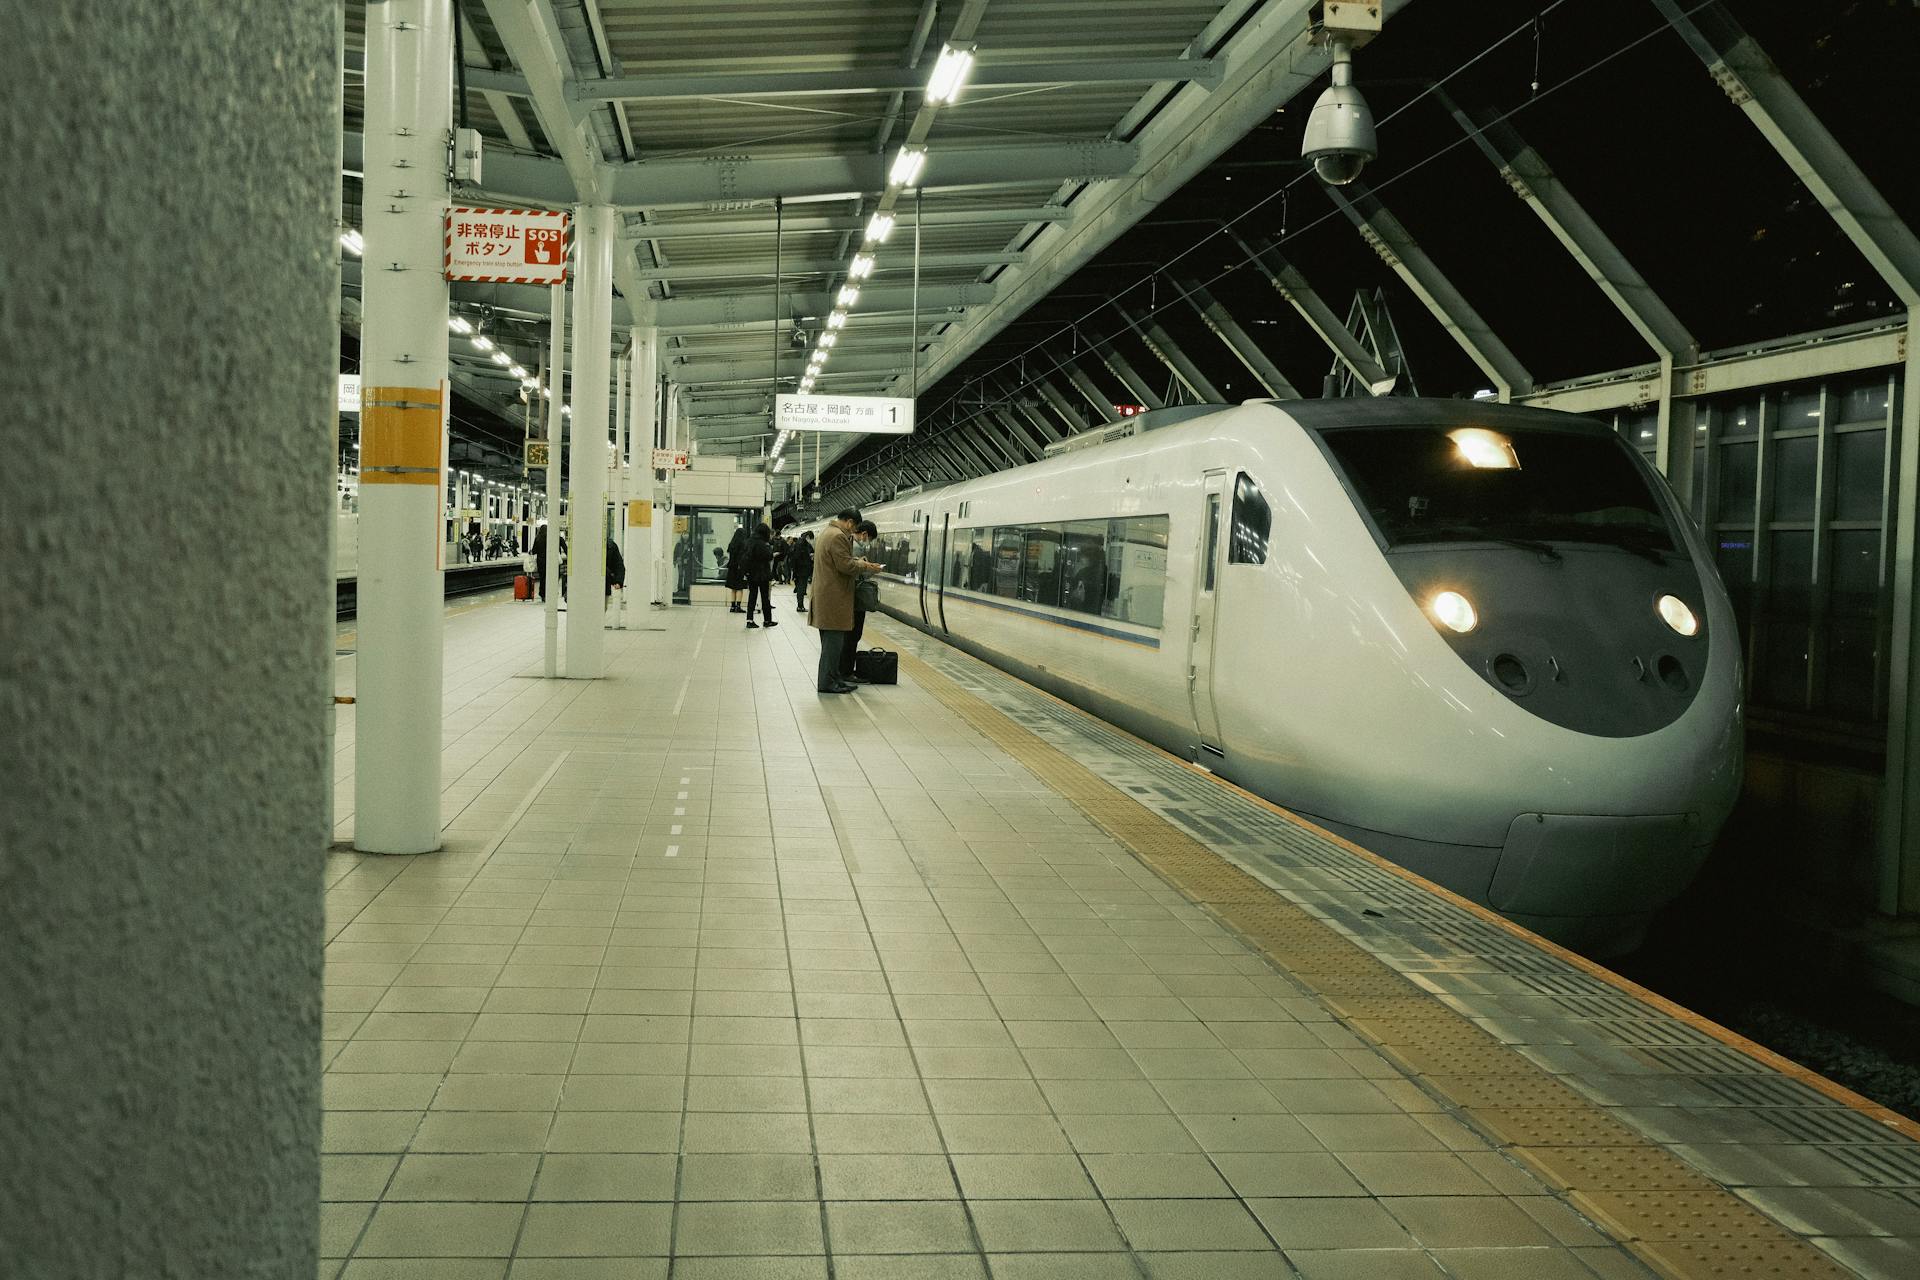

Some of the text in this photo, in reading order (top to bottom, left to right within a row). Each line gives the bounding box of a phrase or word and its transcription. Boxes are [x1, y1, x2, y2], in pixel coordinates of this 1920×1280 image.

[457, 222, 520, 239] 非常停止
[528, 229, 558, 241] SOS
[465, 241, 512, 256] ボタン
[454, 259, 481, 267] Emergency
[855, 407, 874, 416] 方面
[888, 406, 897, 424] 1
[792, 416, 820, 424] Nagoya,
[821, 417, 850, 425] Okazaki
